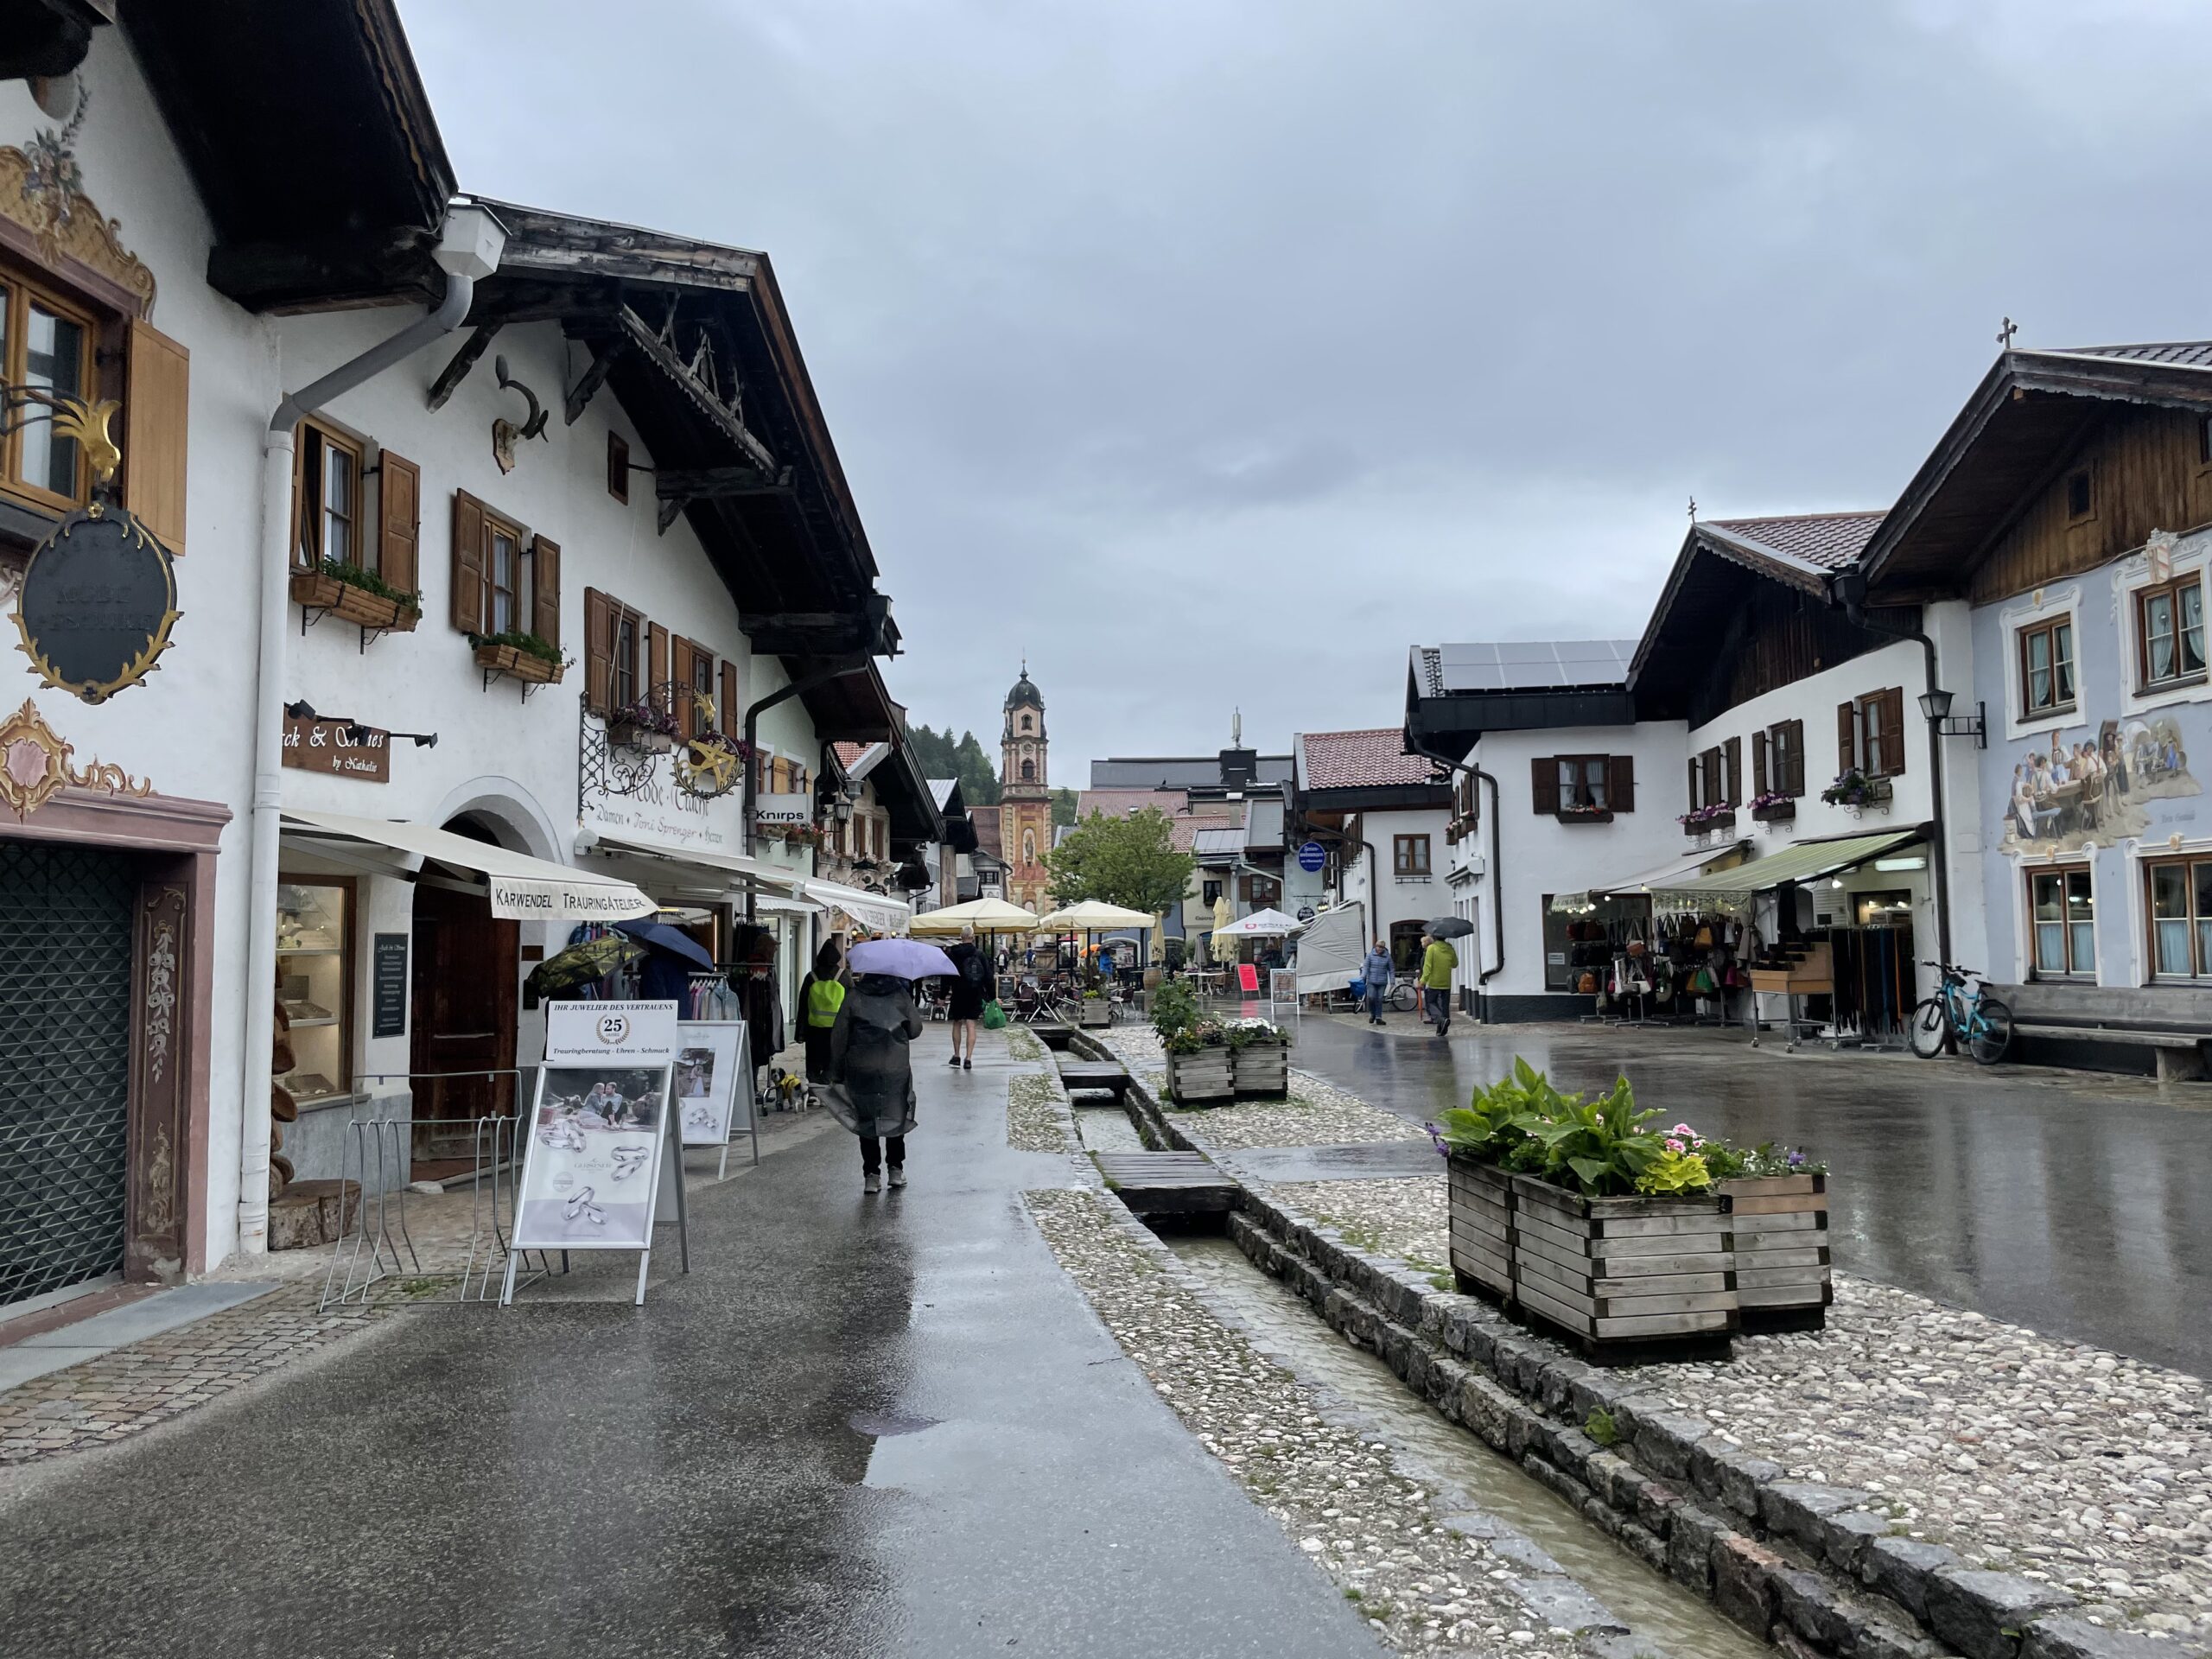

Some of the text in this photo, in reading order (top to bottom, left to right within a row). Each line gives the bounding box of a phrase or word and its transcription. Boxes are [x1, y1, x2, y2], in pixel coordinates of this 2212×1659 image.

[309, 726, 327, 747] &
[332, 755, 378, 773] by Nathalie
[596, 804, 624, 825] Damen
[633, 811, 655, 830] Toni
[658, 817, 697, 843] Sprenger
[756, 810, 804, 822] Knirps
[496, 888, 646, 911] KARWENDEL TRAURINGATELIER
[604, 1019, 622, 1032] 25
